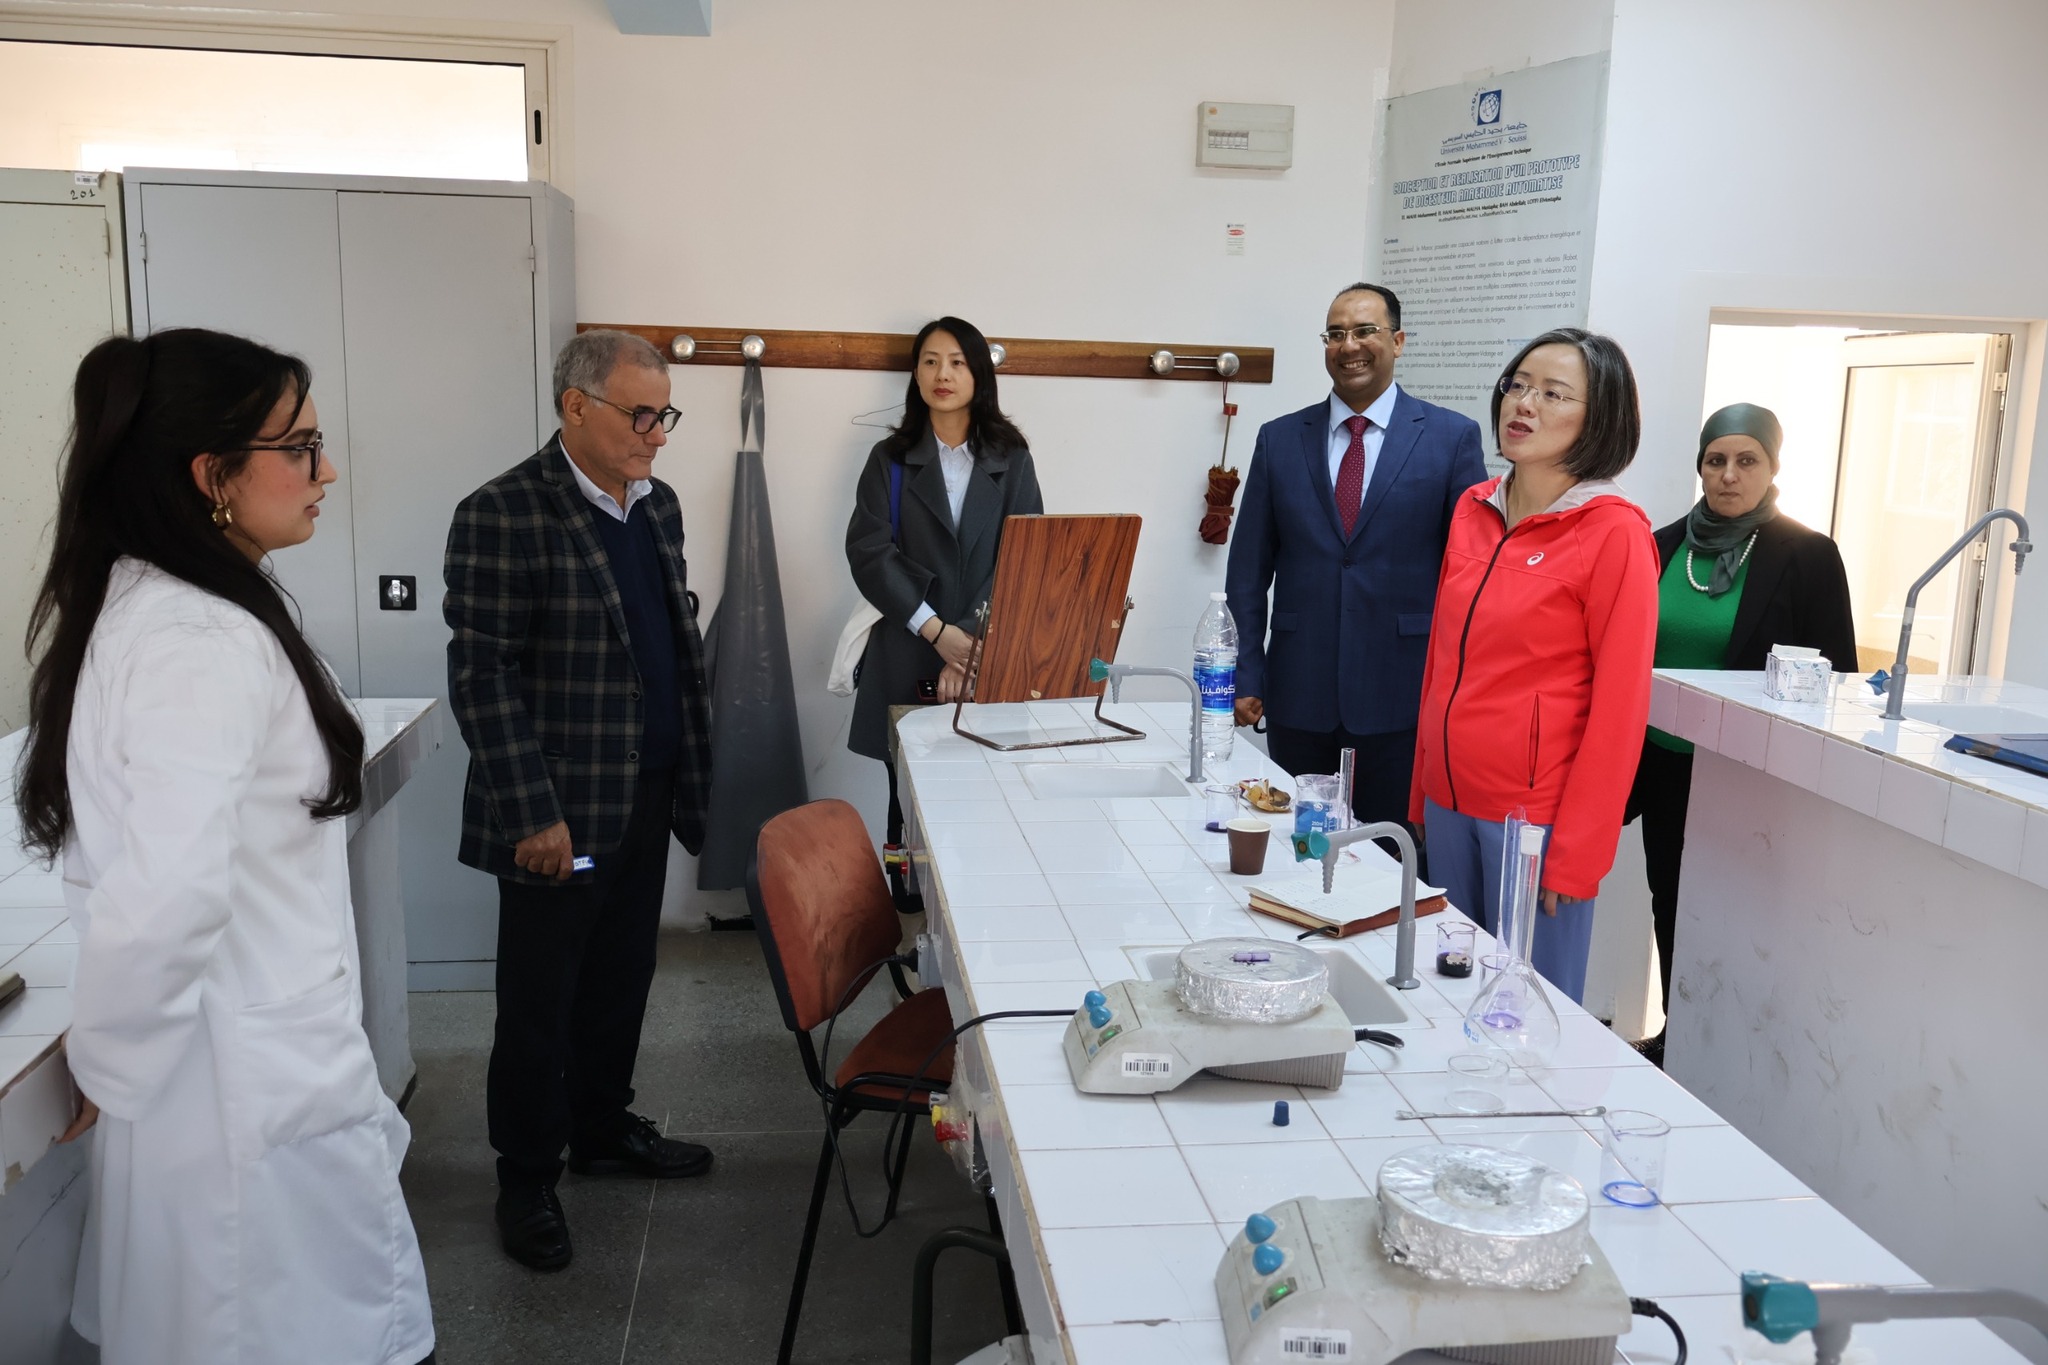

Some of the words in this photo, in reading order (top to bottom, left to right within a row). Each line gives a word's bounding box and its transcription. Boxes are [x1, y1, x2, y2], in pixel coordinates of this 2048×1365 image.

[1440, 145, 1464, 155] Université
[1466, 139, 1498, 151] Mohammed
[1508, 133, 1527, 143] Souissi
[1393, 177, 1438, 195] CONCEPTION
[1439, 175, 1450, 188] ET
[1450, 167, 1503, 187] REALISATION
[1505, 163, 1526, 179] D'UN
[1527, 154, 1580, 175] PROTOTYPE
[70, 188, 96, 200] 201
[1403, 196, 1415, 210] DE
[1415, 190, 1457, 208] DIGESTEUR
[1458, 184, 1504, 202] ANAEROBIE
[1505, 175, 1563, 196] AUTOMATISE
